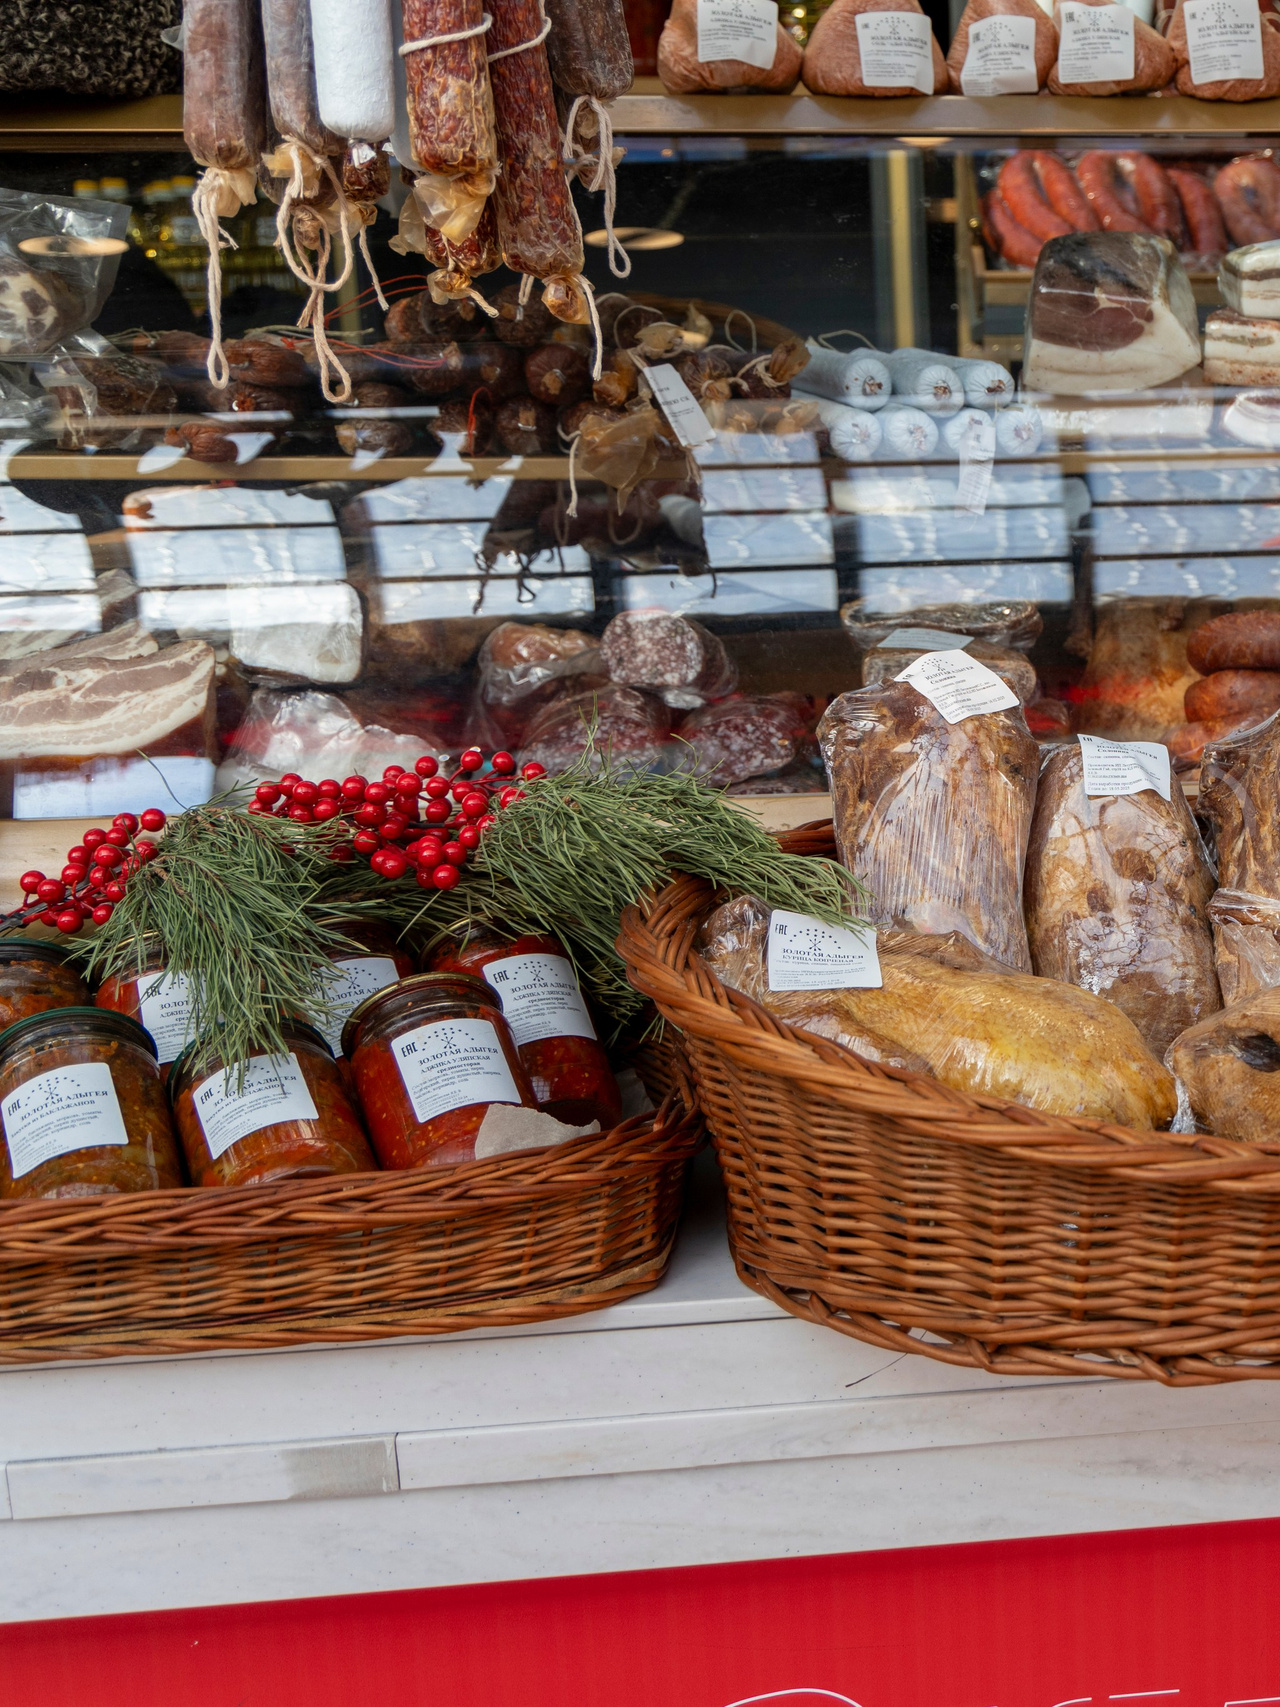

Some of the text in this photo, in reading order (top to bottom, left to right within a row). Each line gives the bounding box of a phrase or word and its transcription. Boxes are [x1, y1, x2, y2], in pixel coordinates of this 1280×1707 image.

[782, 949, 824, 958] ЗОЛОТАЯ
[510, 982, 576, 993] ЗОЛОТАЯ АДЫГЕЯ
[513, 992, 540, 1001] АДЖИКА
[418, 1049, 461, 1066] ЗОЛОТАЯ
[421, 1055, 490, 1074] АДЖИКА УЛЯПСКАЯ
[21, 1091, 108, 1121] ЗОЛОТАЯ АДЫГЕЯ
[40, 1100, 95, 1118] БАКЛАЖАНОВ
